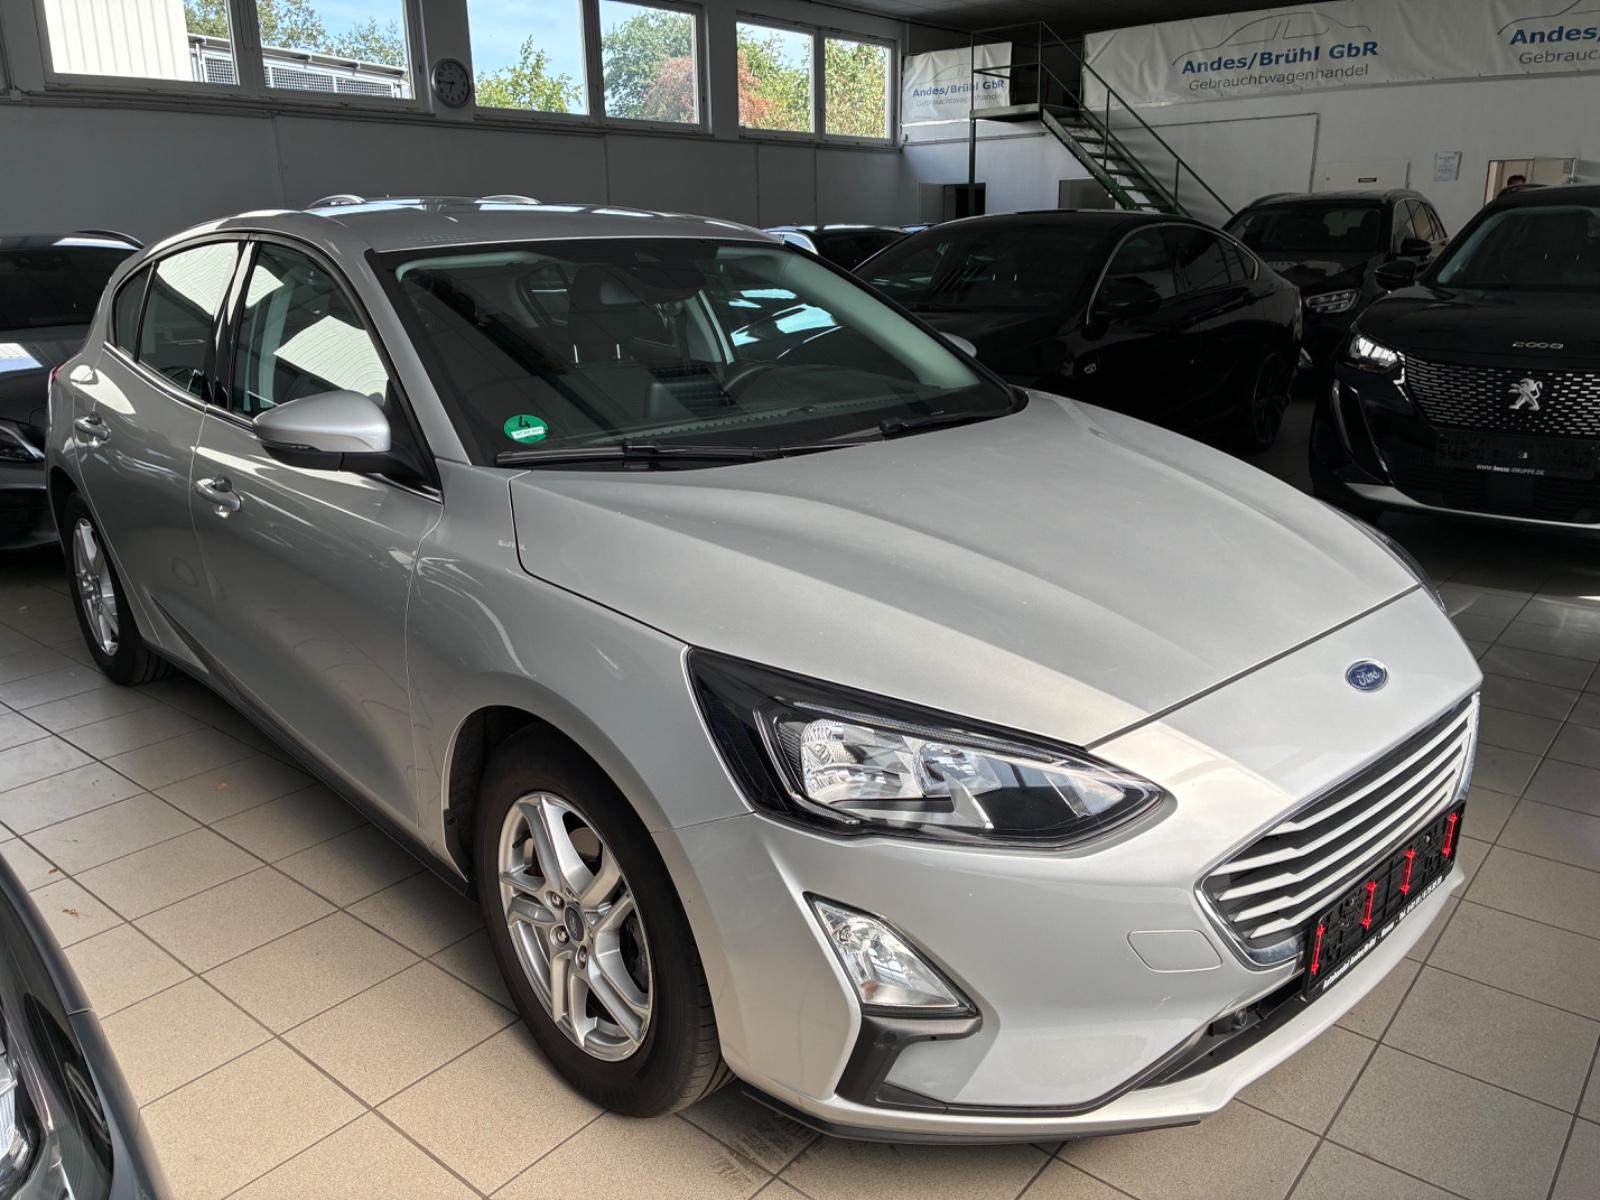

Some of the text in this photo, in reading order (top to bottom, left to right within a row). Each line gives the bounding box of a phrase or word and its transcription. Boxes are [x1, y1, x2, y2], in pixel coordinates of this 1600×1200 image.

[1181, 41, 1379, 75] Andes/Brühl GbR
[982, 80, 1005, 90] GbR
[1189, 63, 1369, 91] Gebrauchtwagenhandel
[518, 415, 531, 428] 4
[1355, 666, 1381, 687] Ford
